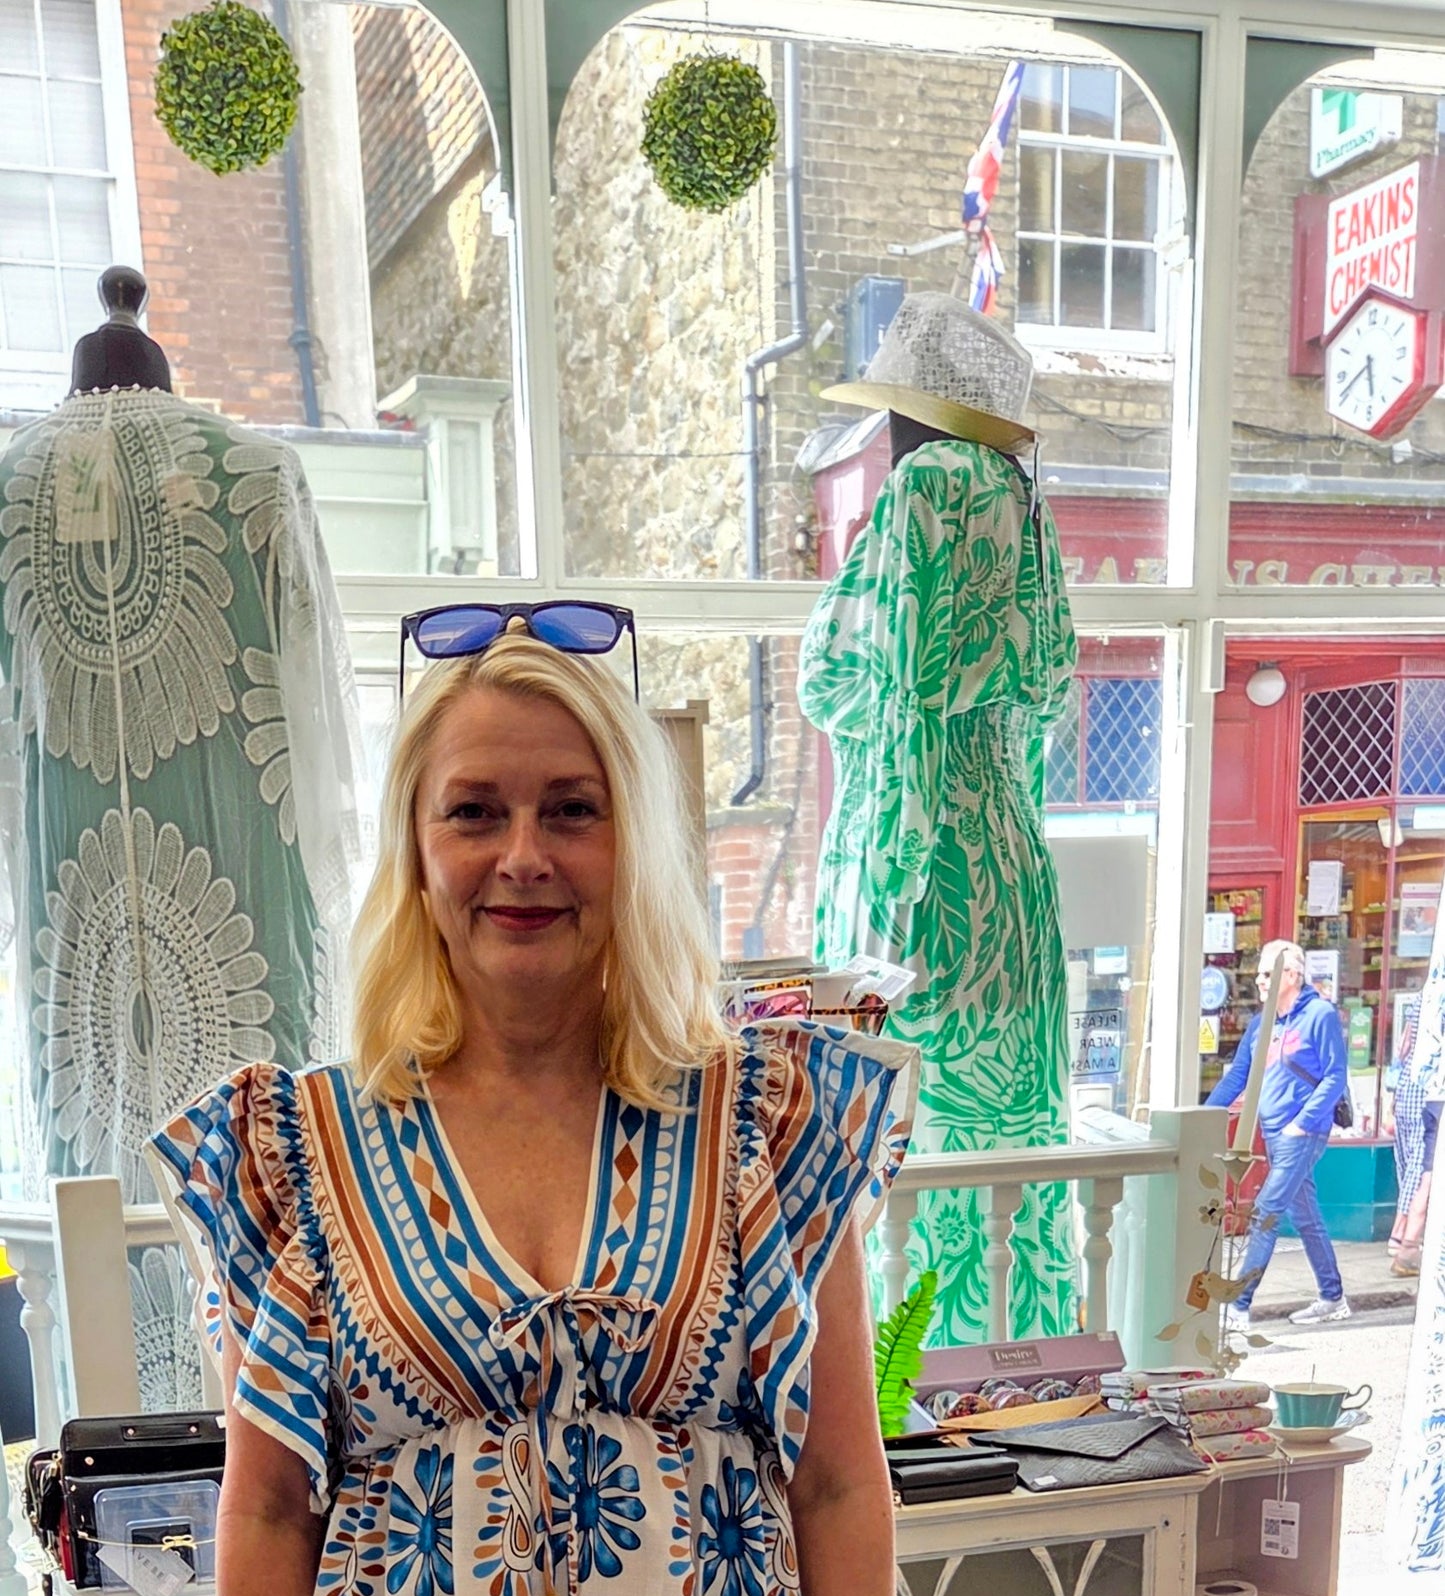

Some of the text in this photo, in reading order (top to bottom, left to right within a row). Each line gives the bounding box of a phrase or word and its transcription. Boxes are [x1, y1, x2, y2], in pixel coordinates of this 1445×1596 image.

[1316, 126, 1377, 169] Pharmacy
[1334, 177, 1414, 256] EAKINS
[1330, 234, 1419, 316] CHEMIST
